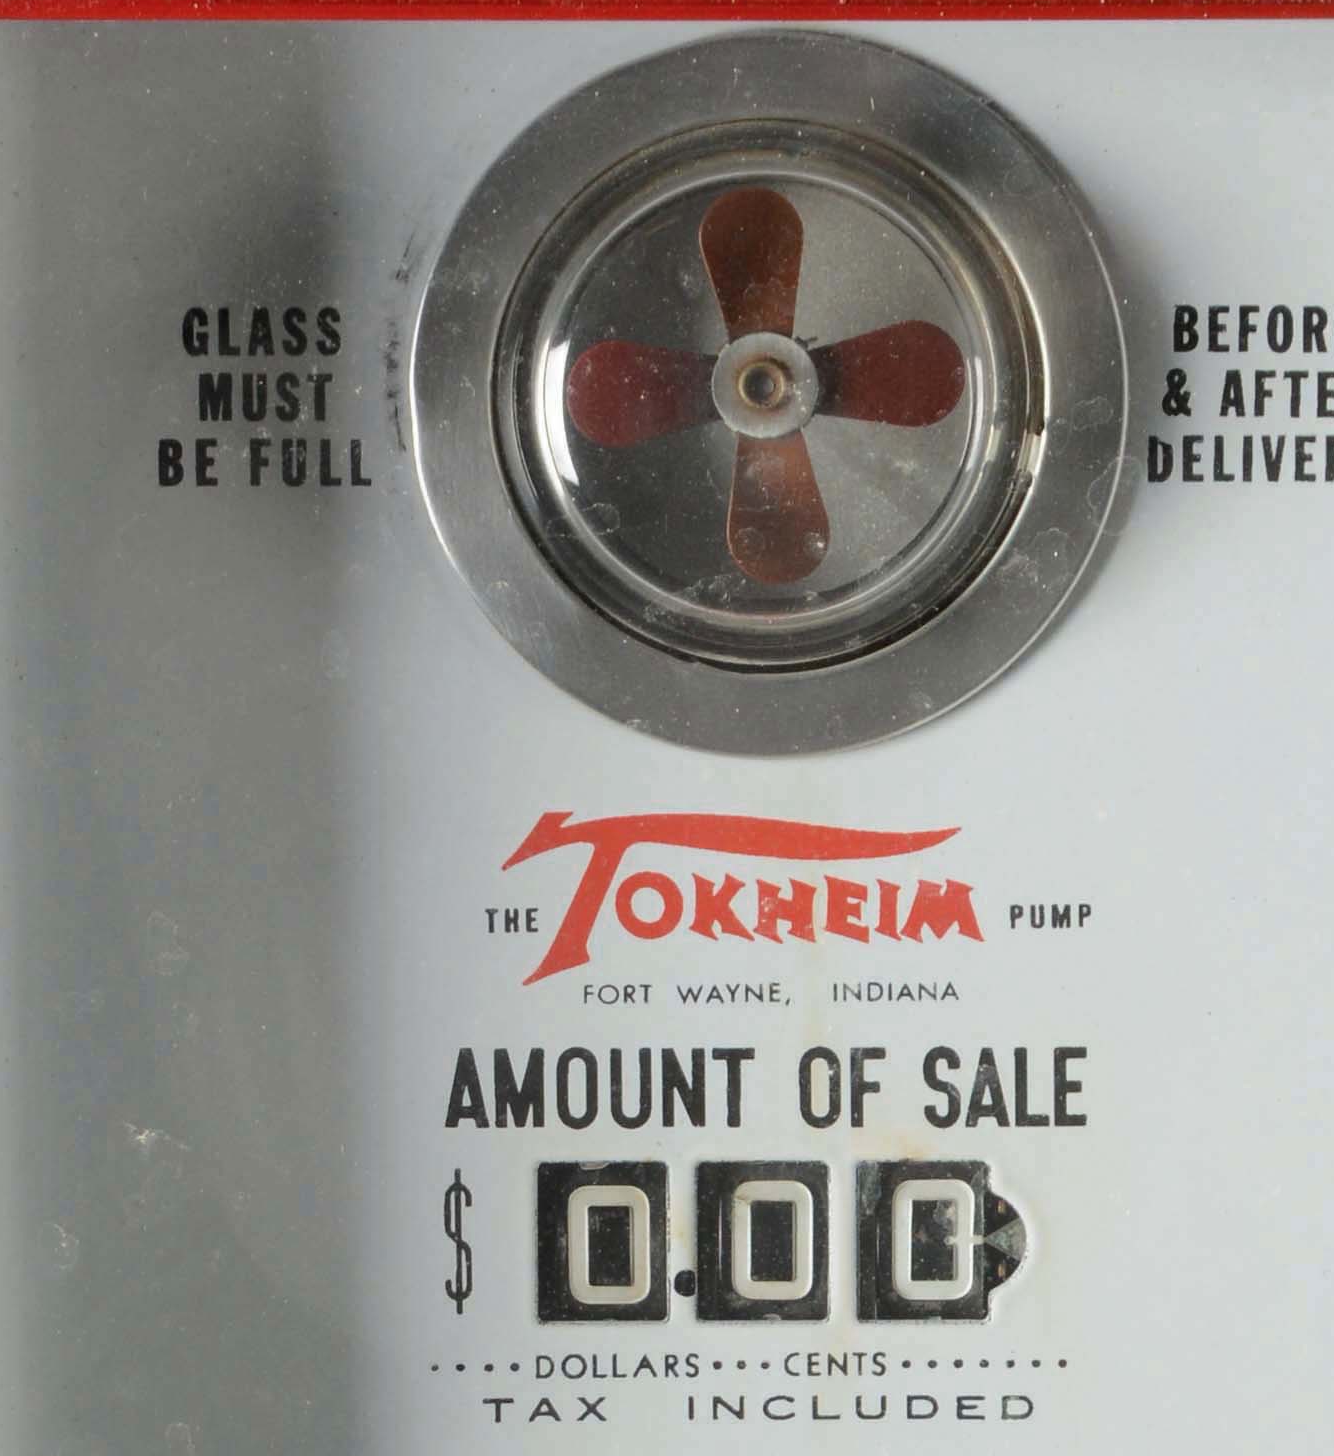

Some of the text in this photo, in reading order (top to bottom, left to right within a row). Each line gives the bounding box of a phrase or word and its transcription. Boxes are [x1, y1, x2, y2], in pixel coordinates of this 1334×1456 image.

[182, 307, 341, 357] GLASS
[199, 372, 333, 422] MUST
[1162, 368, 1191, 416] &
[158, 438, 372, 487] BE FULL
[485, 811, 1091, 985] THE TOKHEIM PUMP
[584, 982, 959, 1005] FORT WAYNE, INDIANA
[445, 1046, 1087, 1130] AMOUNT OF SALE
[444, 1169, 472, 1315] $
[483, 1395, 1033, 1423] TAX INCLUDED
